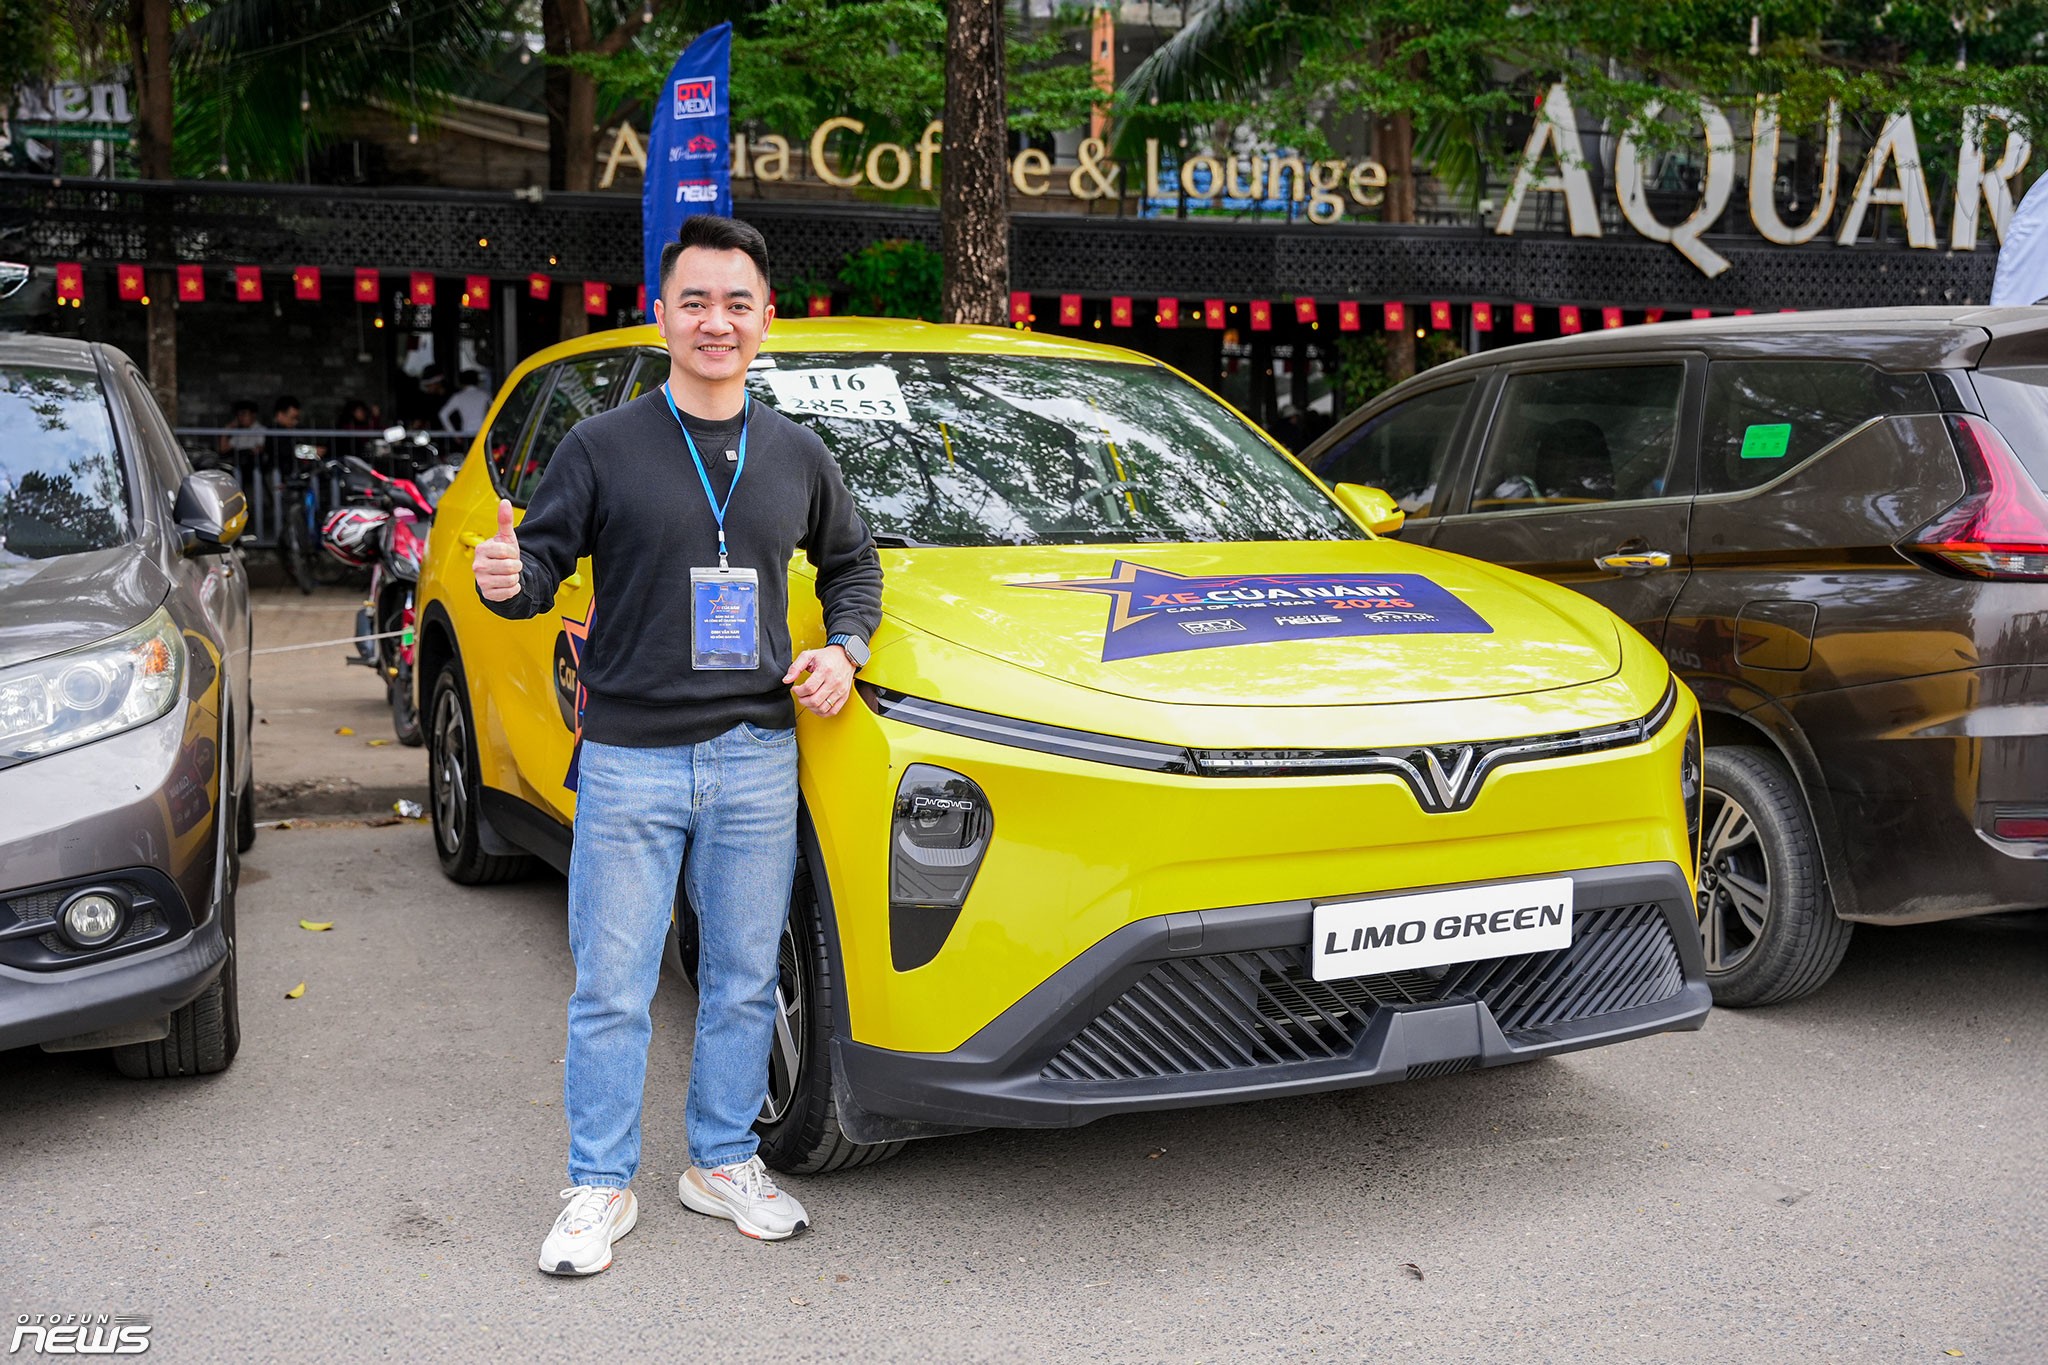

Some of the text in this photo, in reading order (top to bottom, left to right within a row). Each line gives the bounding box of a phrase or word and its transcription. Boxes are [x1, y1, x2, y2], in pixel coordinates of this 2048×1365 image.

[810, 117, 1050, 196] Cofe
[1069, 137, 1121, 200] &
[1145, 138, 1388, 225] Lounge
[791, 398, 896, 416] 285.53
[1142, 585, 1401, 606] XE CỦA NĂM
[1324, 598, 1416, 610] 2026
[1324, 903, 1564, 955] LIMO GREEN
